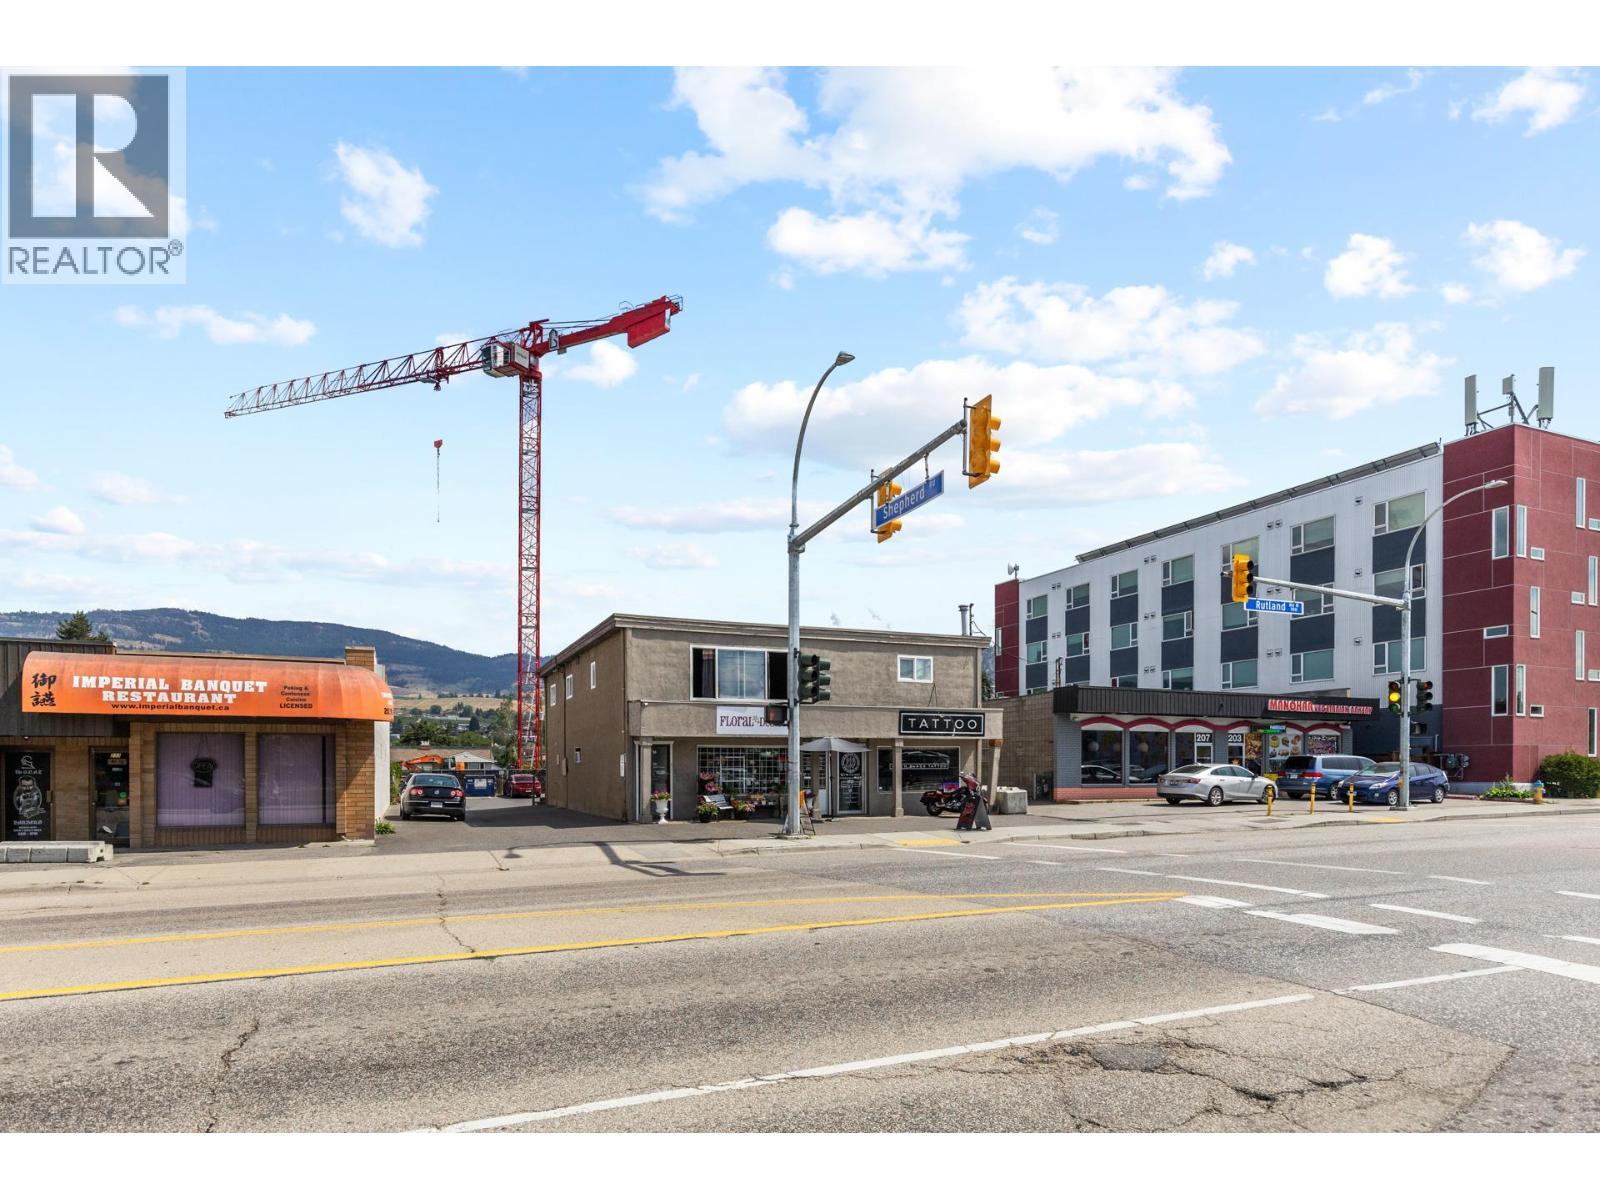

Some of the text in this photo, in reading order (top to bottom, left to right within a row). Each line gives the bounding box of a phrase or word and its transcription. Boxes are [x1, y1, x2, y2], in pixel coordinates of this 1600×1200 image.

[883, 486, 925, 520] Shepherd
[1255, 600, 1286, 611] Rutland
[72, 675, 268, 693] IMPERIAL BANQUET
[102, 690, 237, 704] RESTAURANT
[111, 702, 230, 711] www.imperialbanquet.ca
[1268, 699, 1312, 712] MANOHAR
[908, 718, 978, 730] TATTOO
[1196, 734, 1211, 742] 207
[1228, 734, 1242, 742] 203
